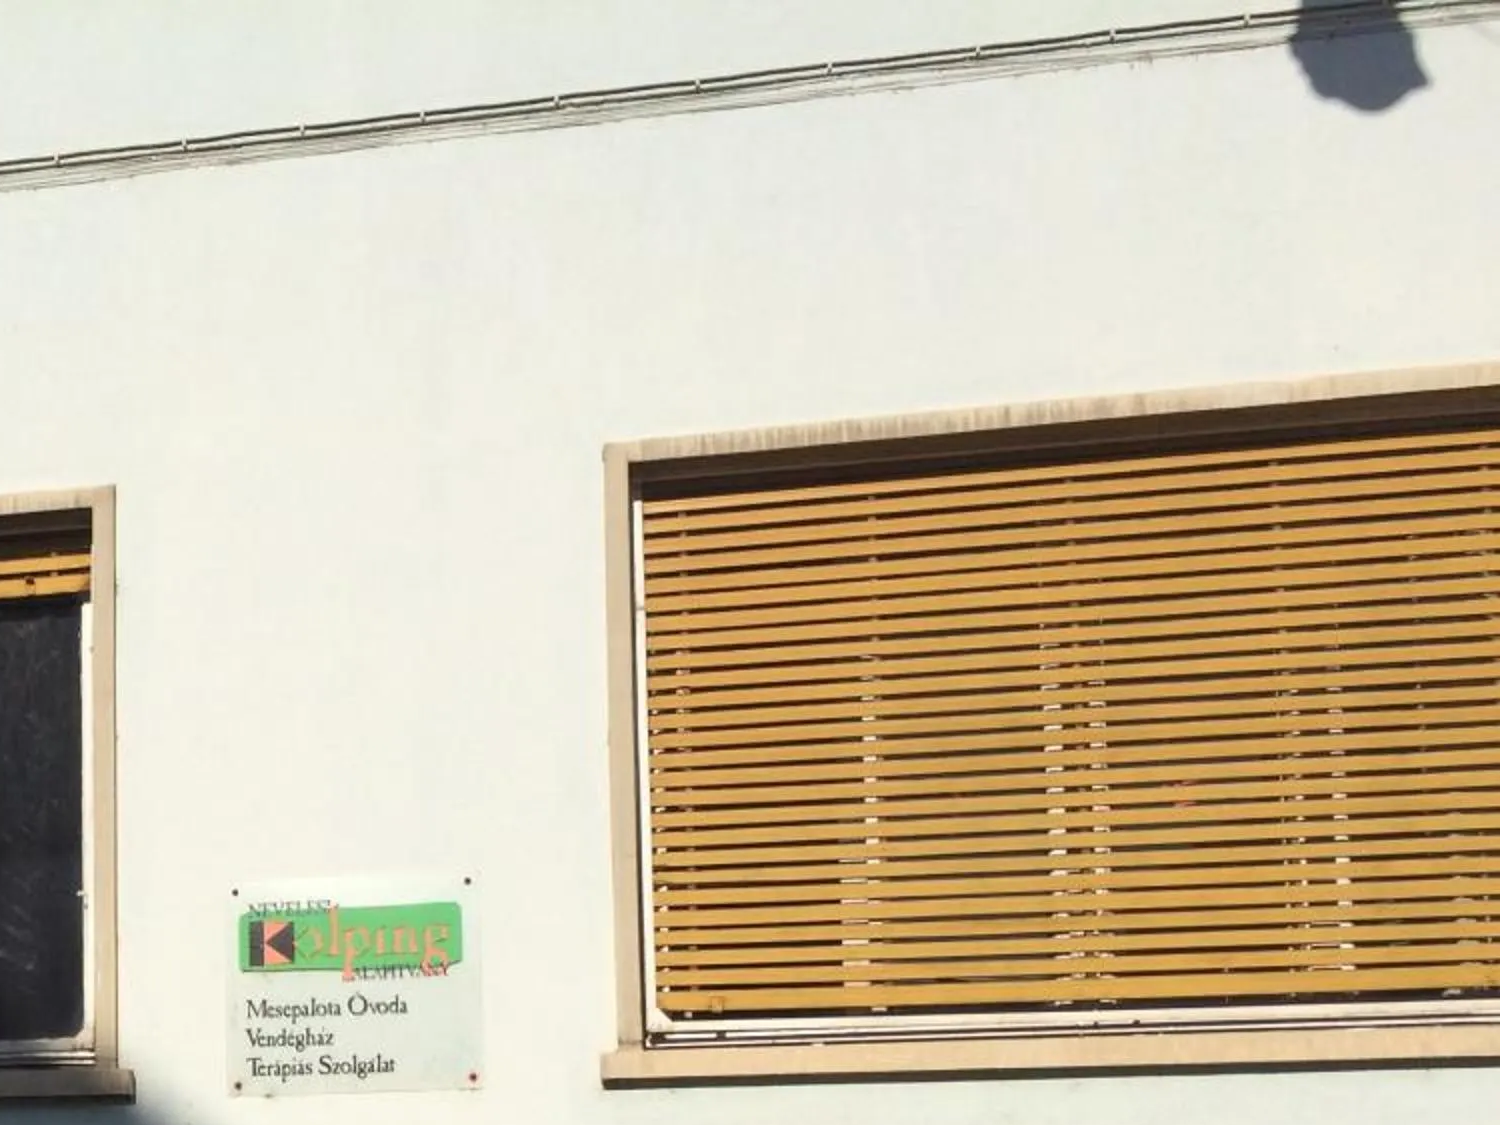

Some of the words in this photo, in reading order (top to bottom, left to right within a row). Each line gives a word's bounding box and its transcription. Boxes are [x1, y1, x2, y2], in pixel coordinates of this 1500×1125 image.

[248, 902, 451, 982] Kolping
[246, 997, 342, 1025] Mesepalota
[347, 991, 409, 1017] Óvoda
[245, 1026, 335, 1053] Vendégház
[246, 1055, 313, 1083] Terápiás
[317, 1053, 396, 1080] Szolgálat
